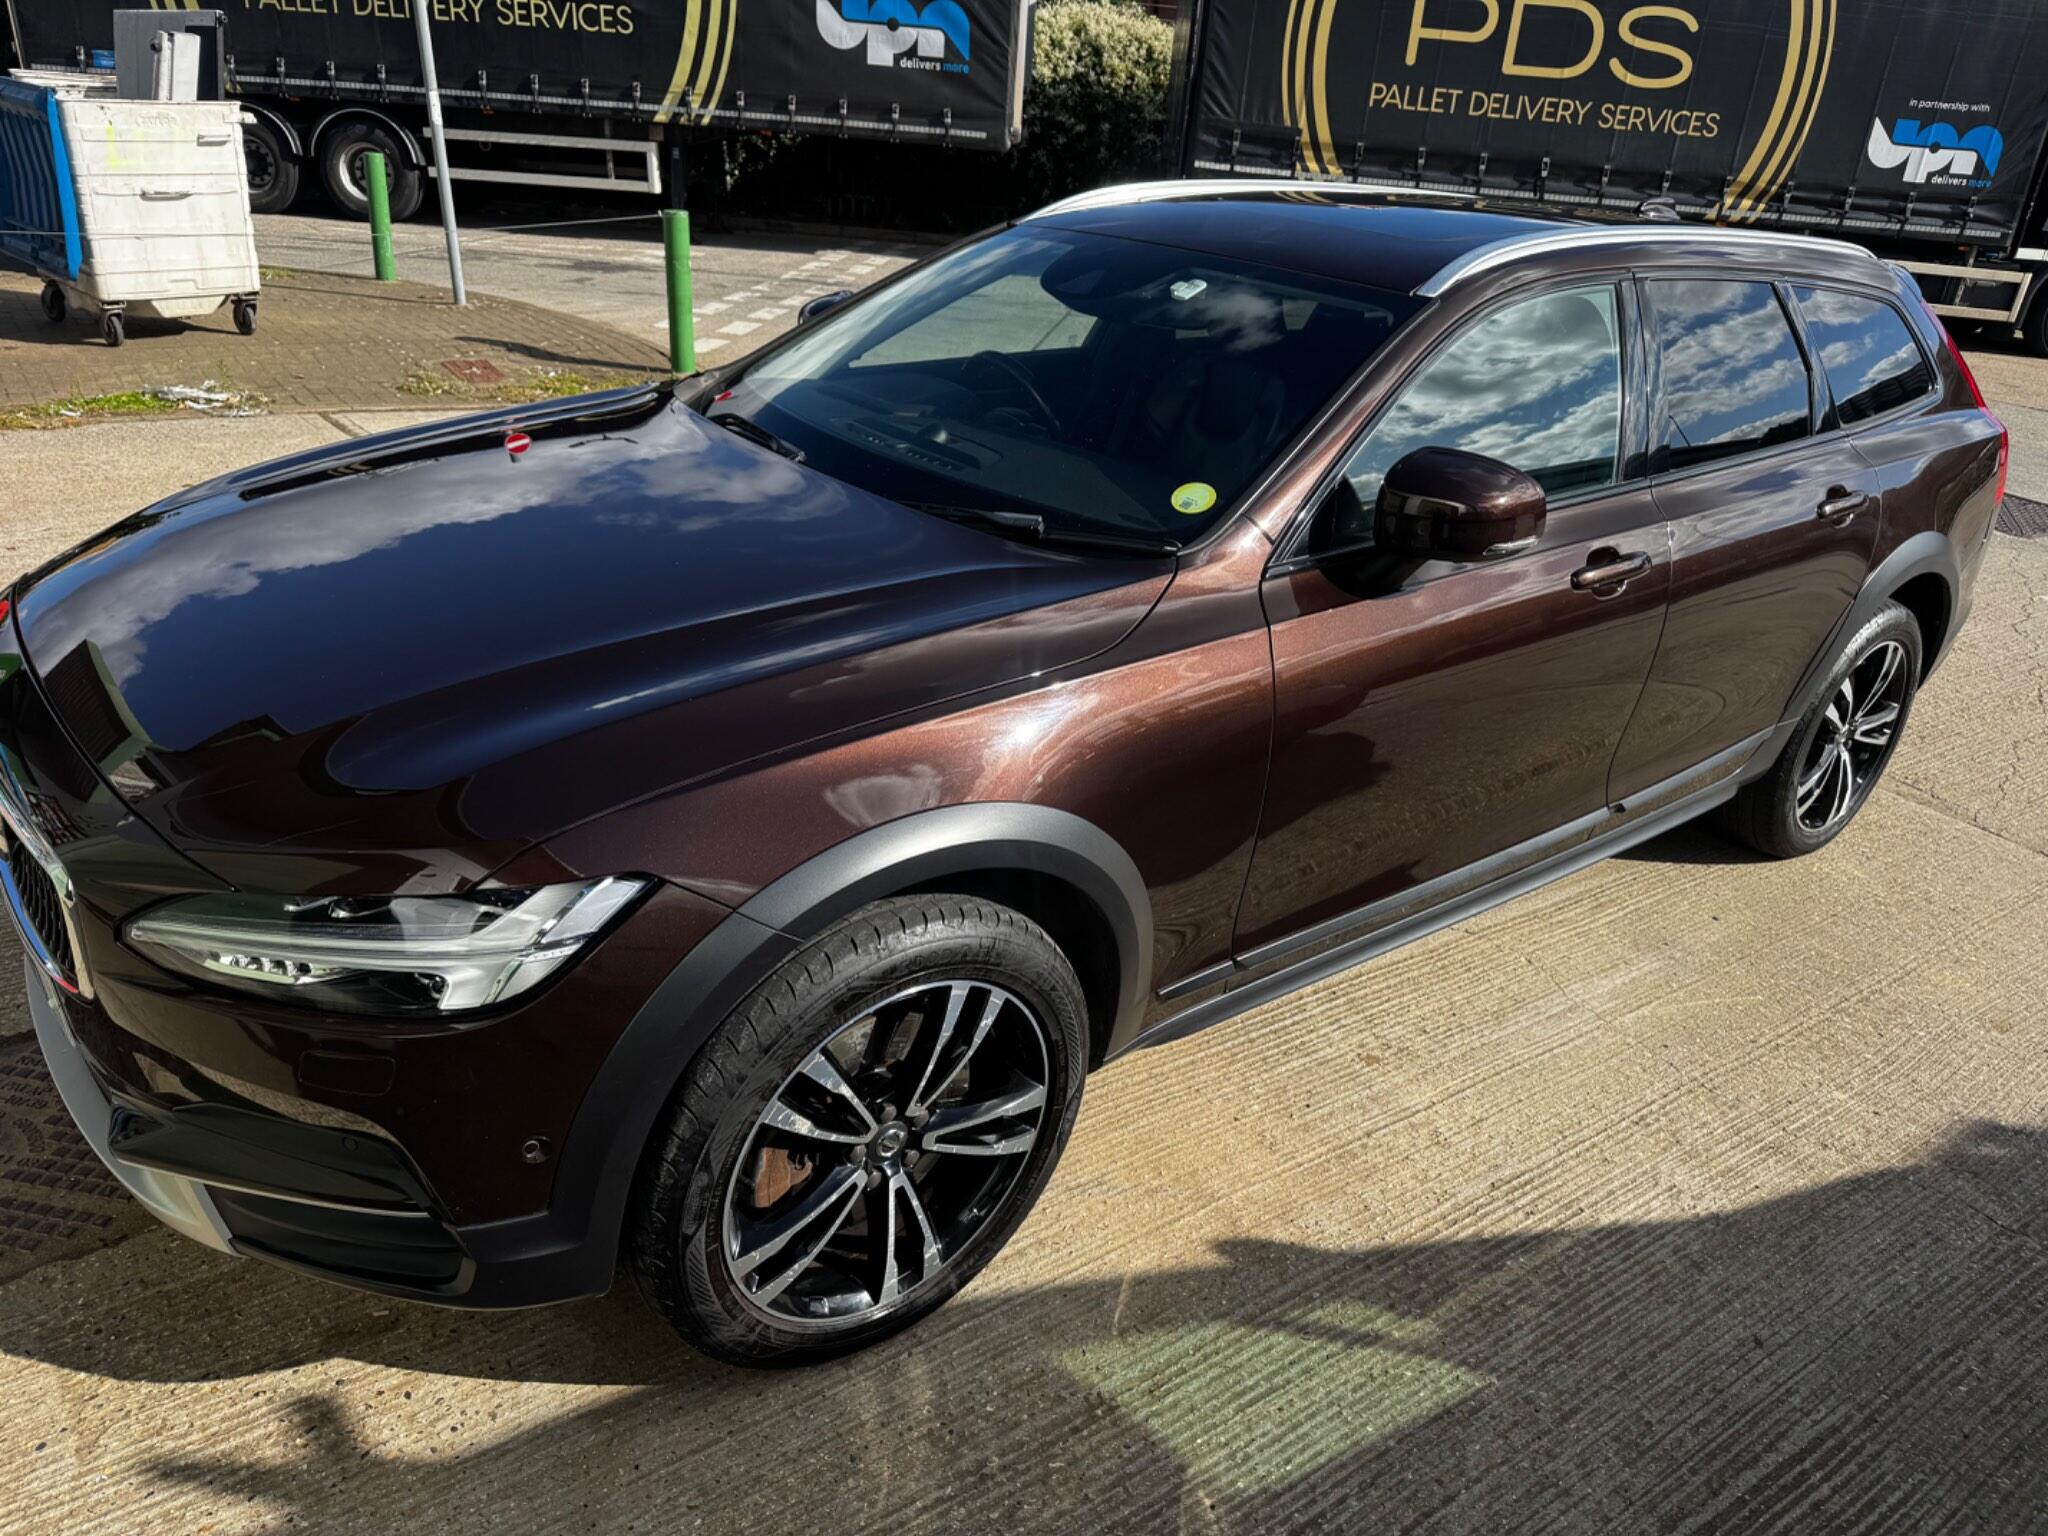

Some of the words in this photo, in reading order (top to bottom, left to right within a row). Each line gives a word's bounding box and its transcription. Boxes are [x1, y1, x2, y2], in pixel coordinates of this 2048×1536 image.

[352, 0, 483, 23] DELIERY
[496, 0, 634, 34] SERVICES
[1404, 0, 1699, 89] PDS
[899, 57, 941, 71] delivers
[942, 63, 970, 74] more
[1369, 82, 1463, 115] PALLET
[1468, 91, 1593, 126] DELIVERY
[1598, 103, 1721, 138] SERVICES
[1908, 97, 1918, 107] in
[1918, 99, 1969, 112] partnership
[1971, 103, 1991, 113] with
[1931, 174, 1967, 186] delivers
[1968, 178, 1992, 188] more
